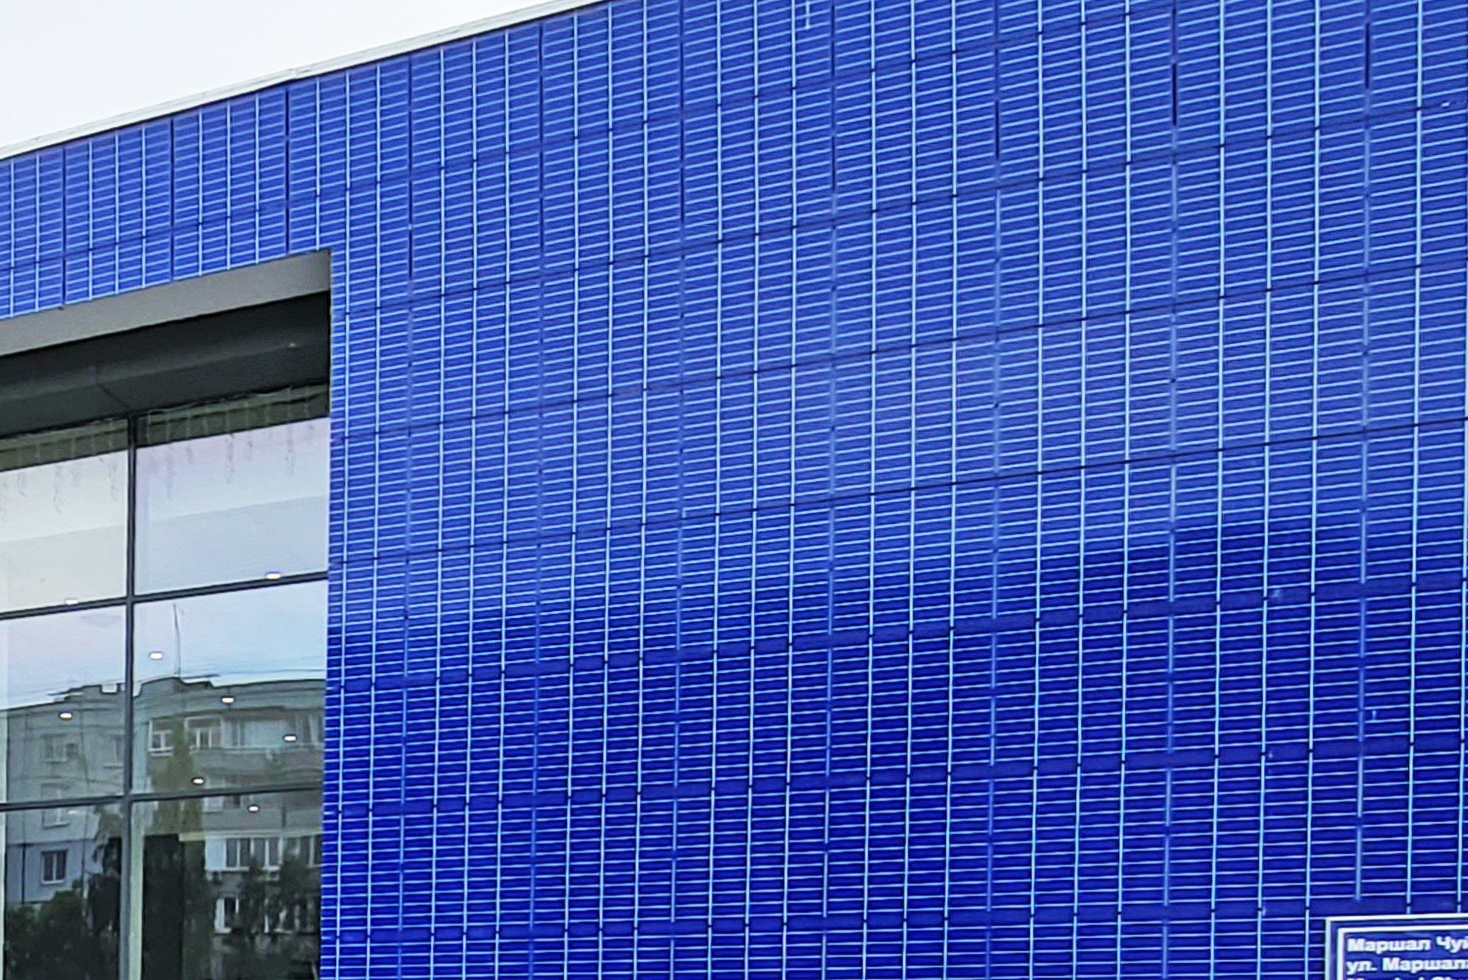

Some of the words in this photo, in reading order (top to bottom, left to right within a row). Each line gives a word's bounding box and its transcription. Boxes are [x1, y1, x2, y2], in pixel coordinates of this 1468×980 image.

[1347, 938, 1431, 954] Маршал
[1346, 960, 1377, 975] ул.
[1382, 957, 1468, 973] Маршал
